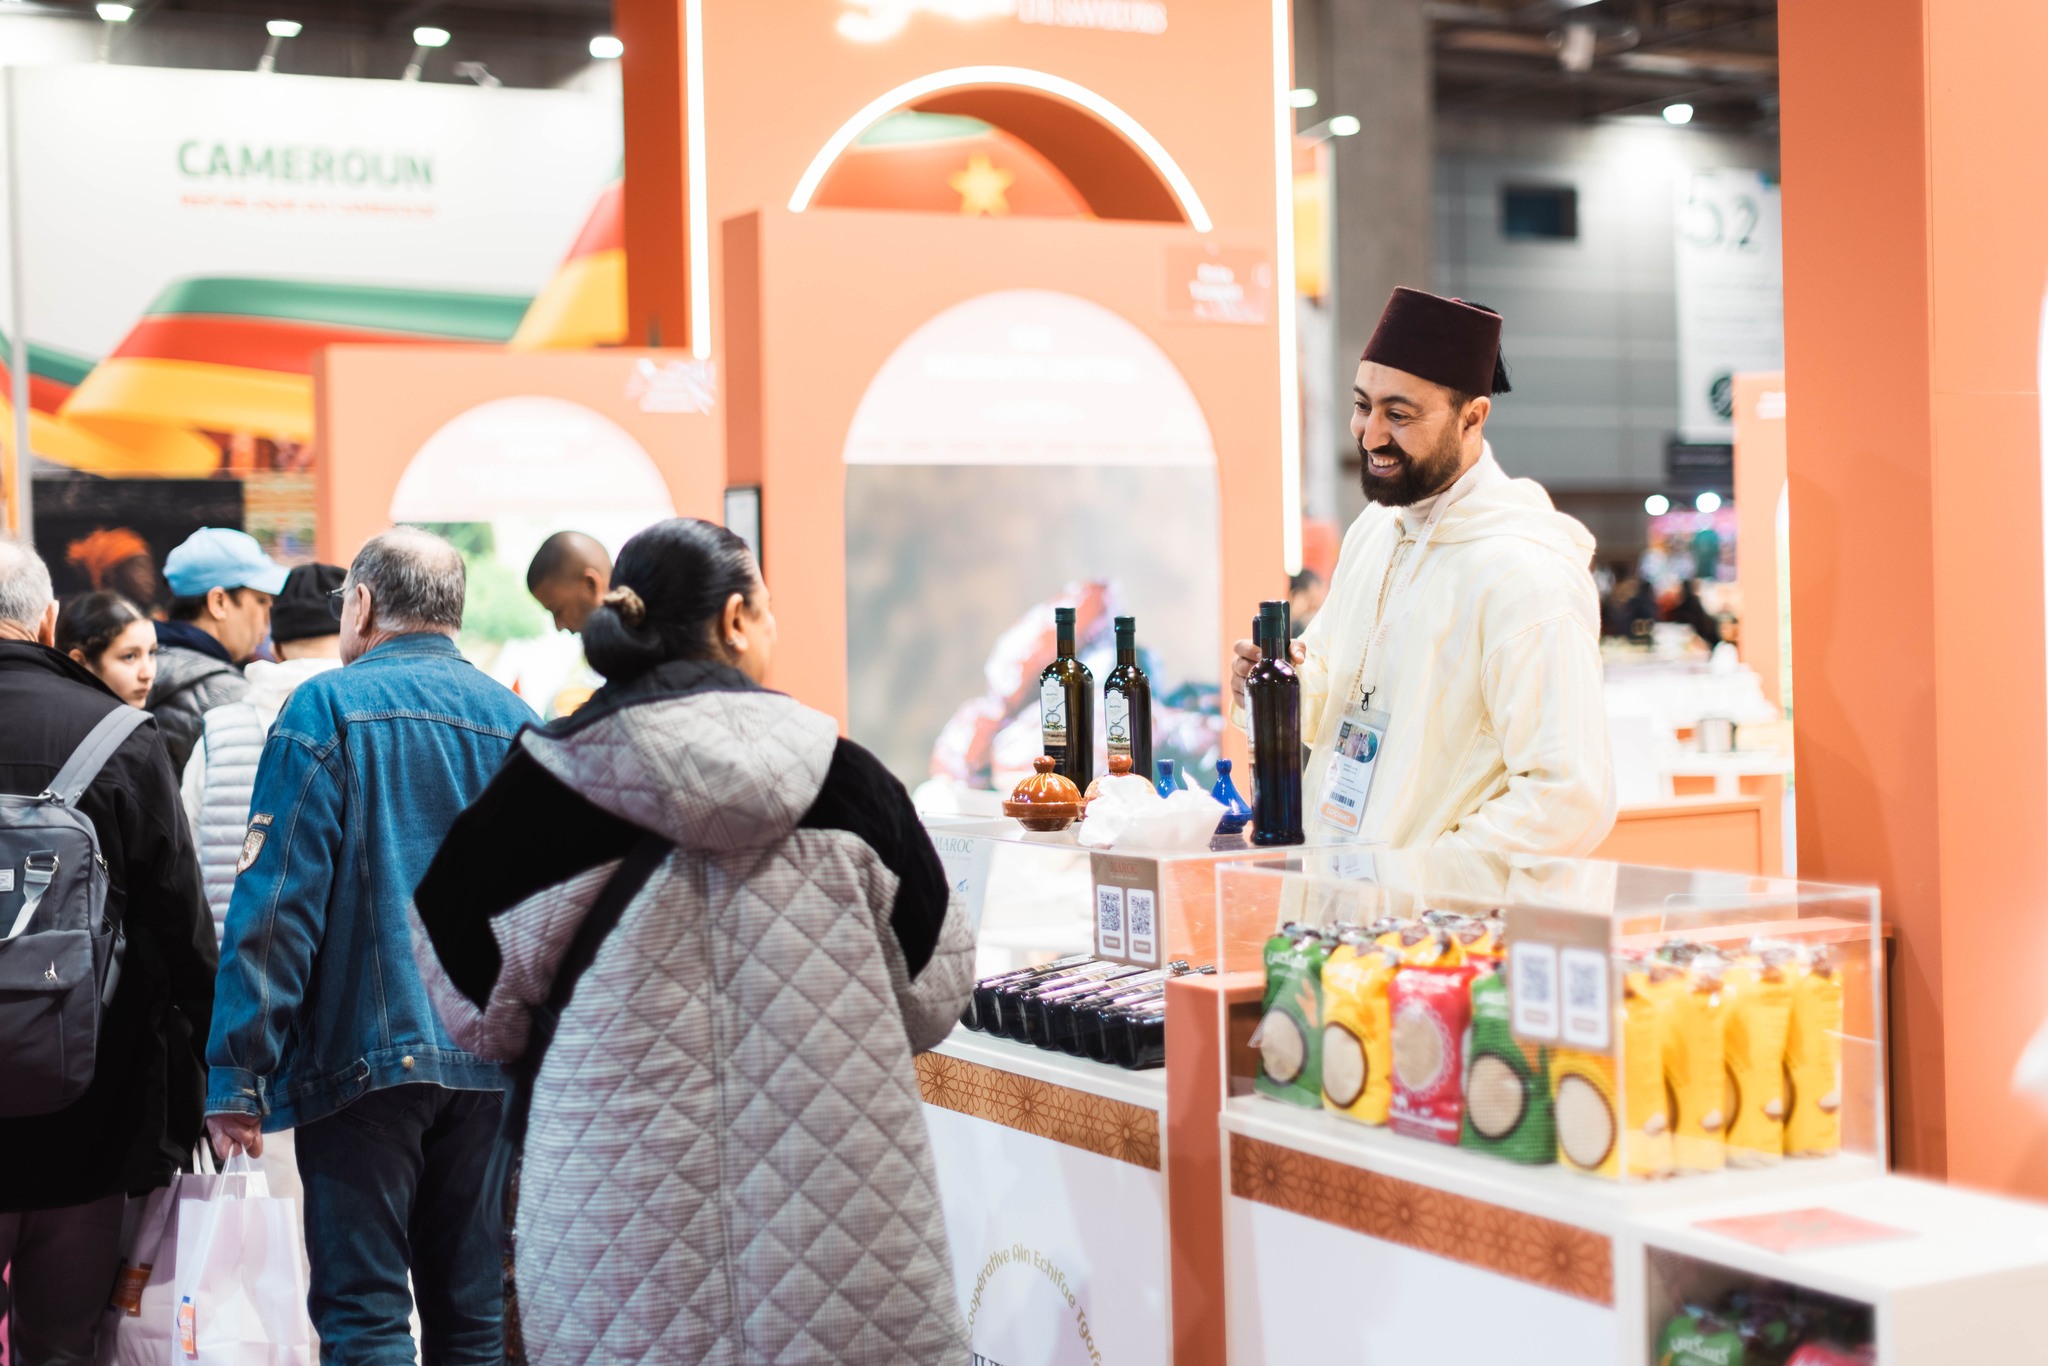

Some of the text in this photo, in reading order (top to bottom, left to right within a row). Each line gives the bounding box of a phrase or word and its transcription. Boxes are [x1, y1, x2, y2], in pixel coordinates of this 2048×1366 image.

[176, 139, 434, 187] CAMEROUN
[1109, 861, 1138, 875] MAROC
[1012, 1243, 1031, 1265] Ain
